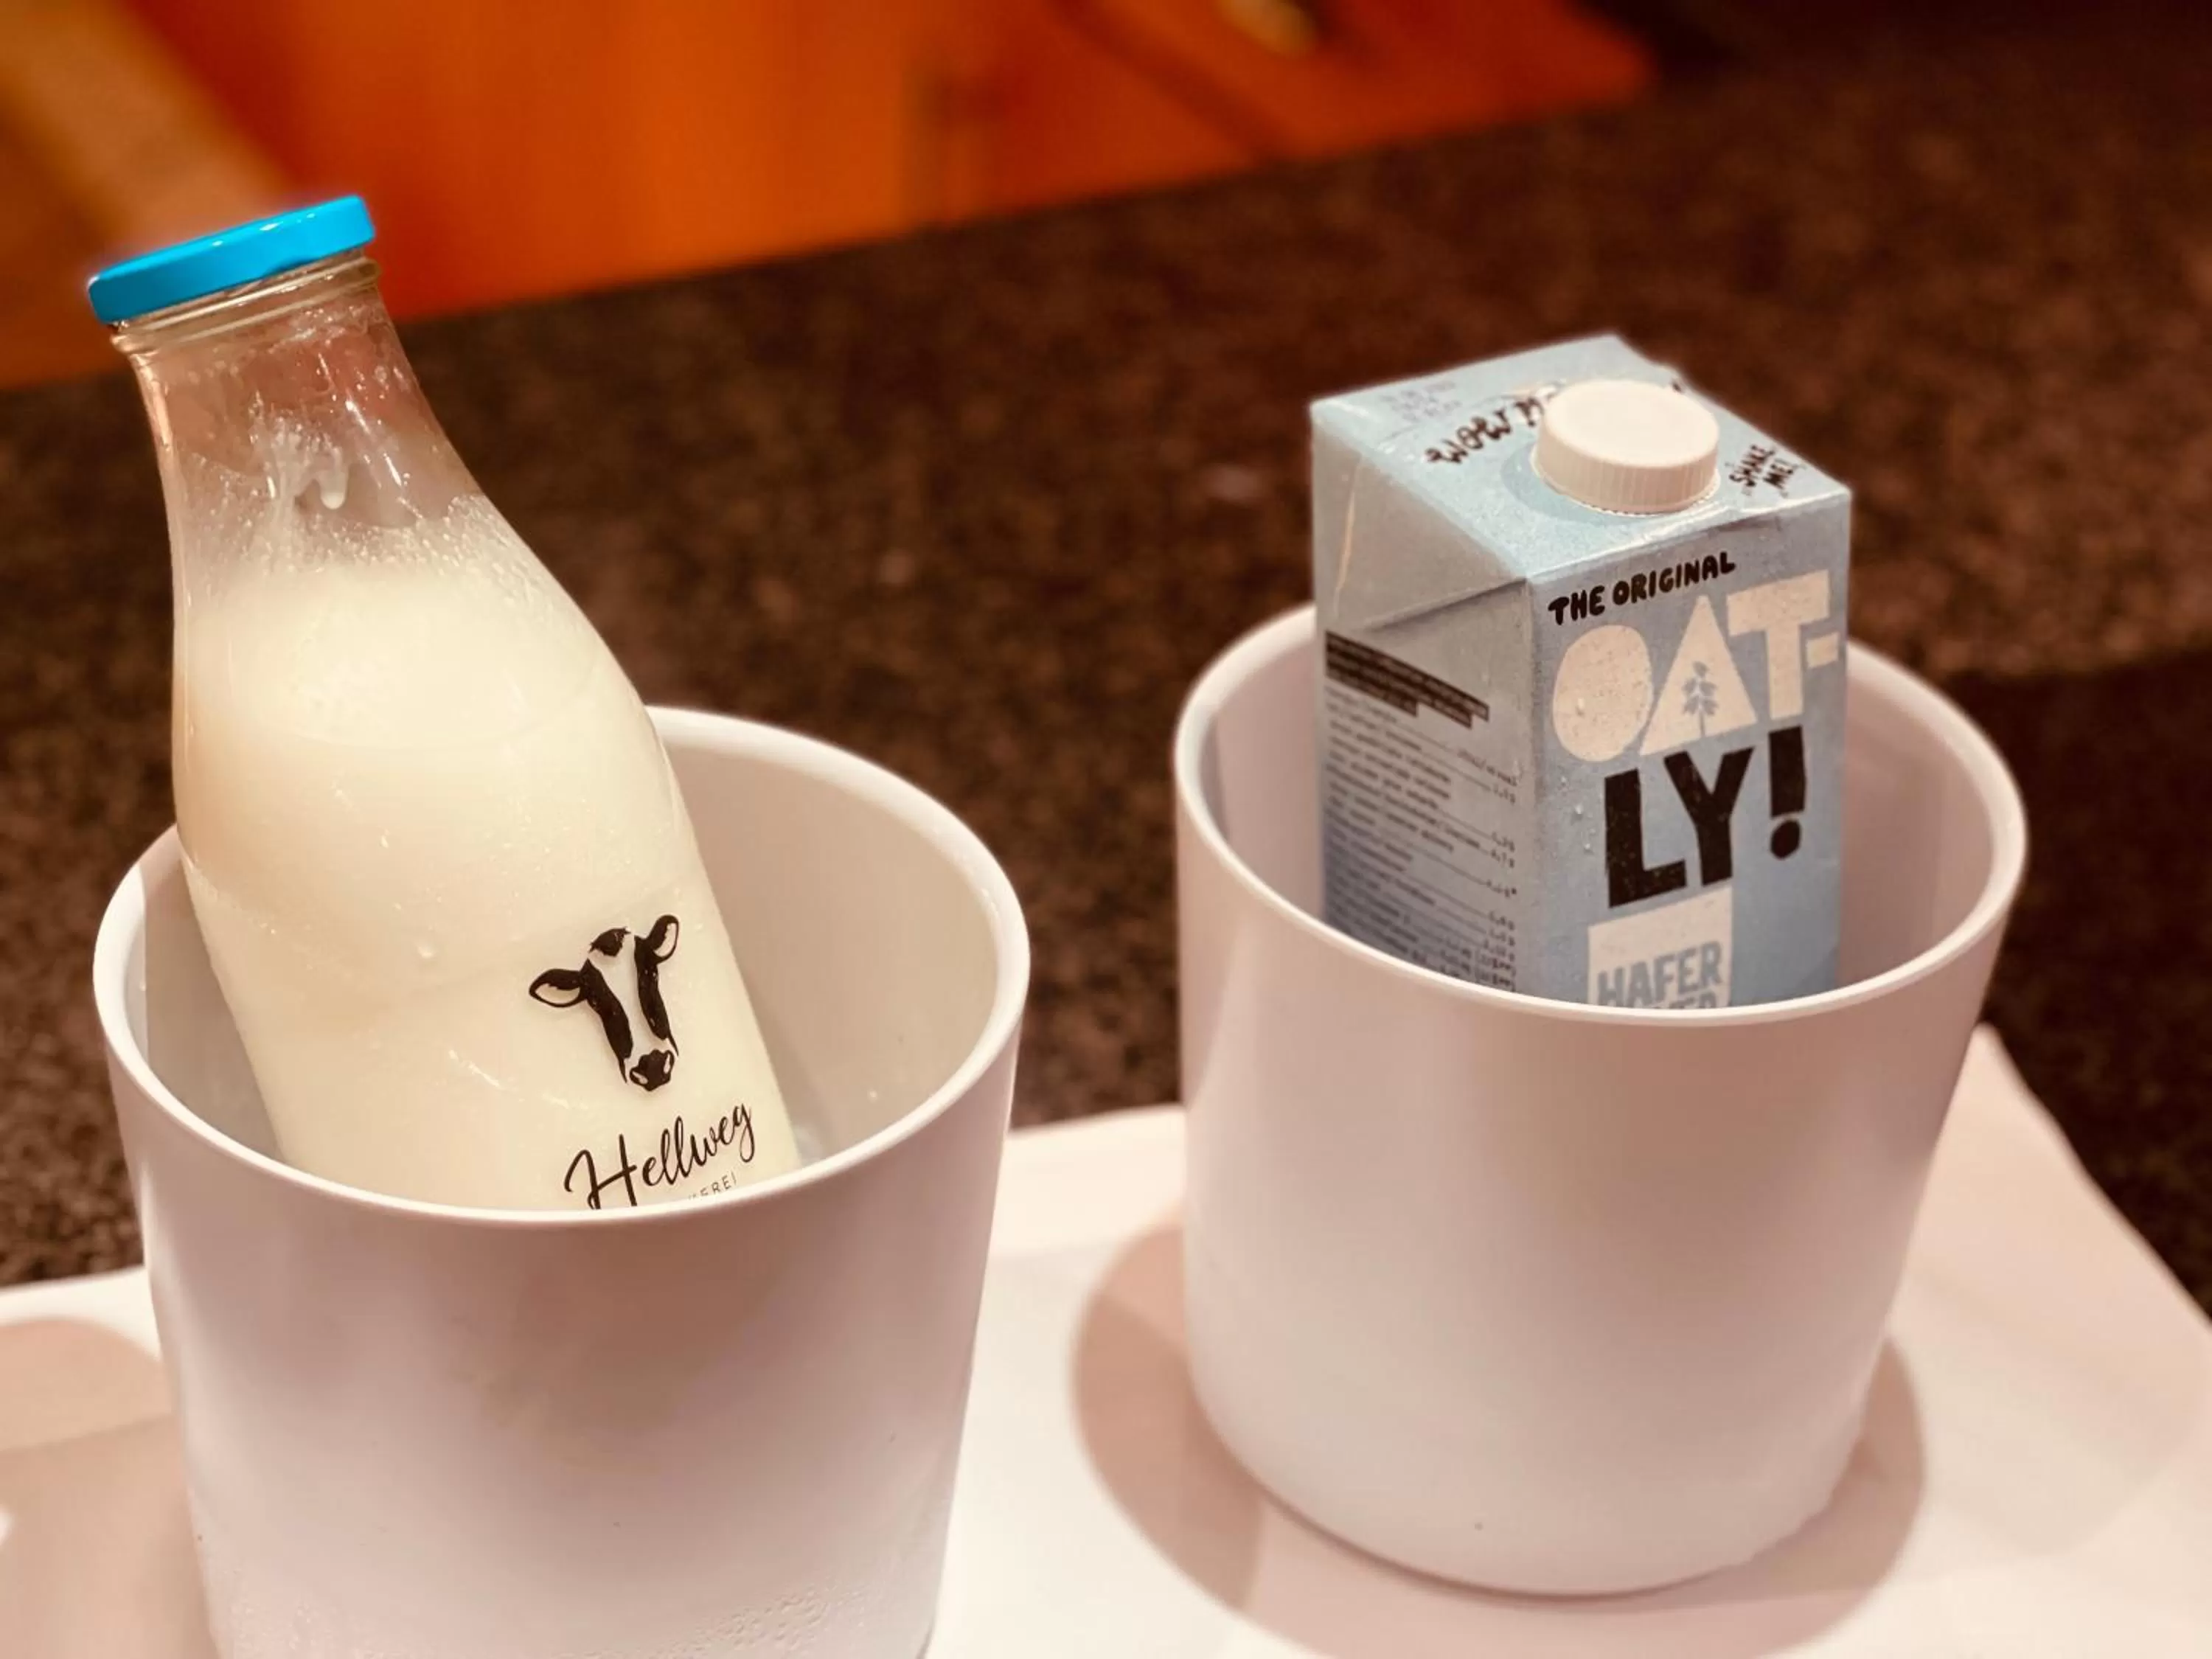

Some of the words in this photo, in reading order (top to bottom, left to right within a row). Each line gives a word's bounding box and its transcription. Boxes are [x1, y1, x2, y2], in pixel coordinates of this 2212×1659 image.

[1548, 585, 1606, 625] THE
[1612, 551, 1736, 606] ORIGINAL
[1604, 725, 1806, 908] LY!
[1596, 940, 1723, 1009] HAFER
[563, 1102, 756, 1210] Hellweg
